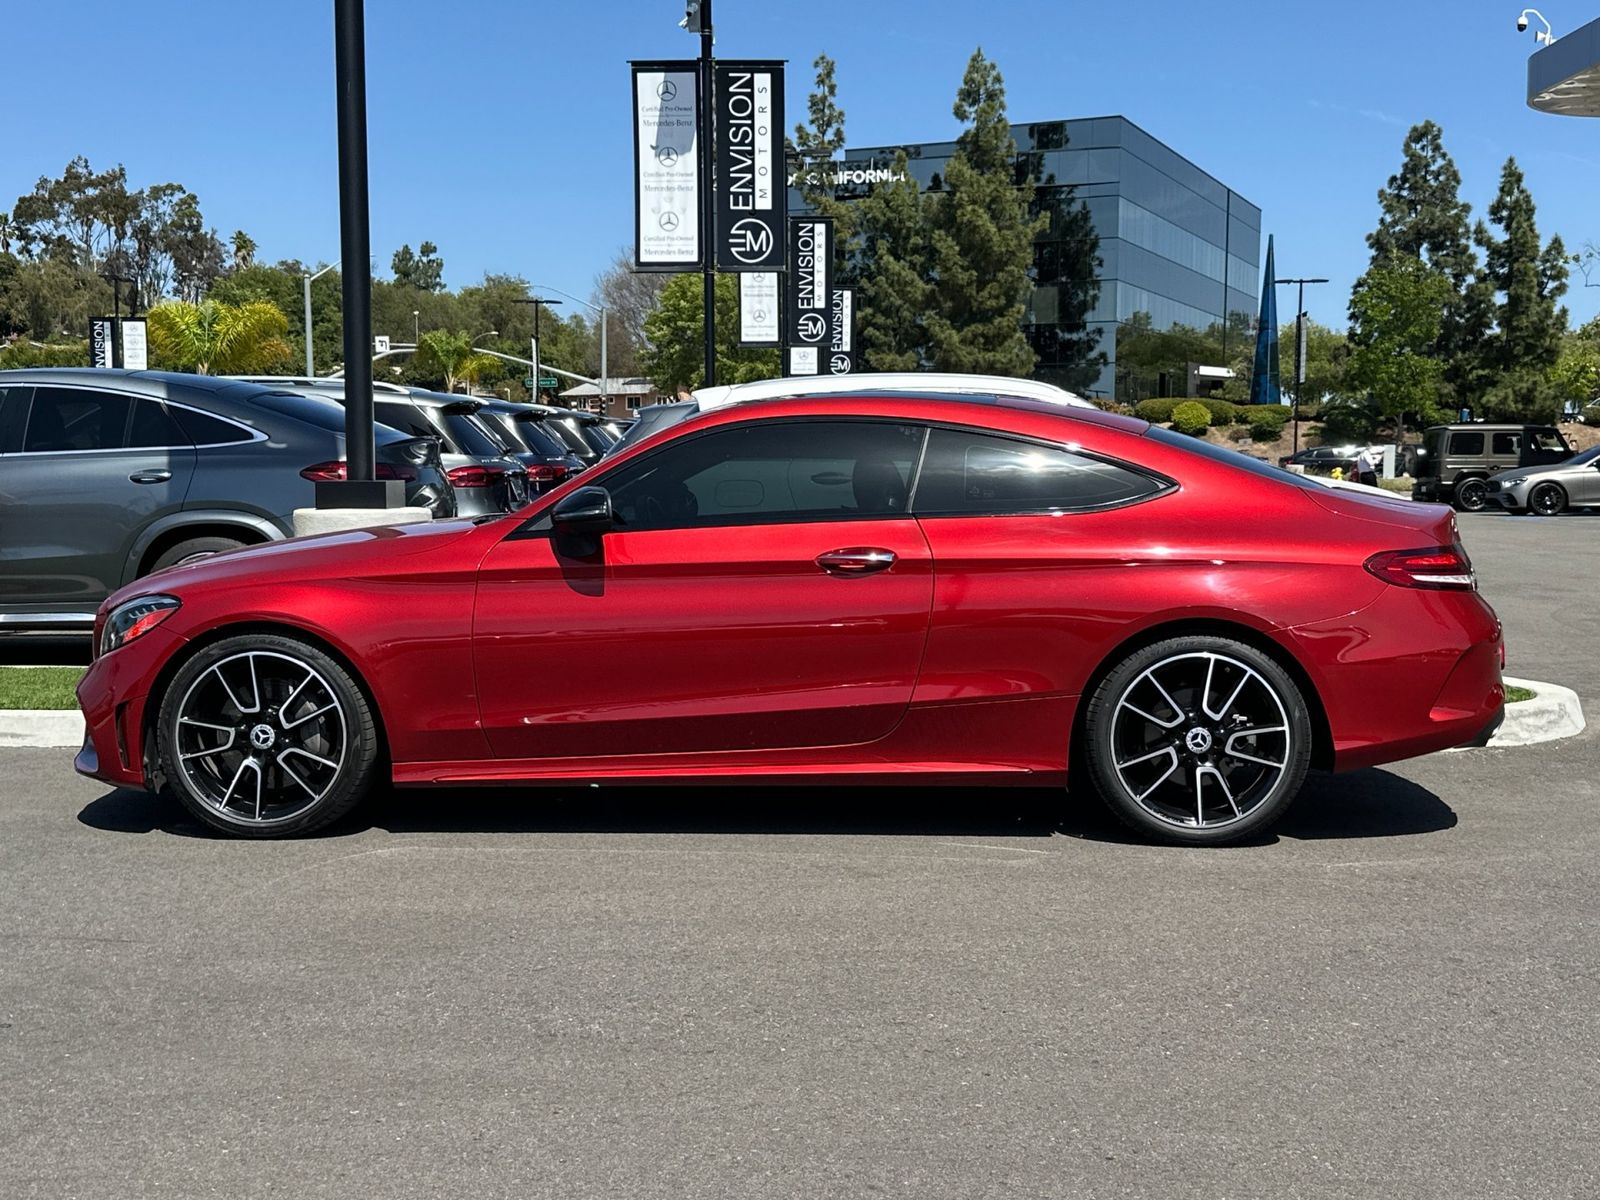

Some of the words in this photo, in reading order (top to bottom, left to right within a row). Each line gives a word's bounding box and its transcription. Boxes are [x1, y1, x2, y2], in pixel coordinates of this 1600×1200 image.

[642, 118, 693, 127] Mercedes-Benz
[728, 72, 752, 210] ENVISION
[757, 86, 768, 199] MOTORS
[643, 183, 694, 193] Mercedes-Benz
[644, 247, 694, 257] Mercedes-Benz
[798, 222, 814, 309] ENVISION
[93, 320, 105, 368] NVISION
[831, 289, 843, 351] ENVISION
